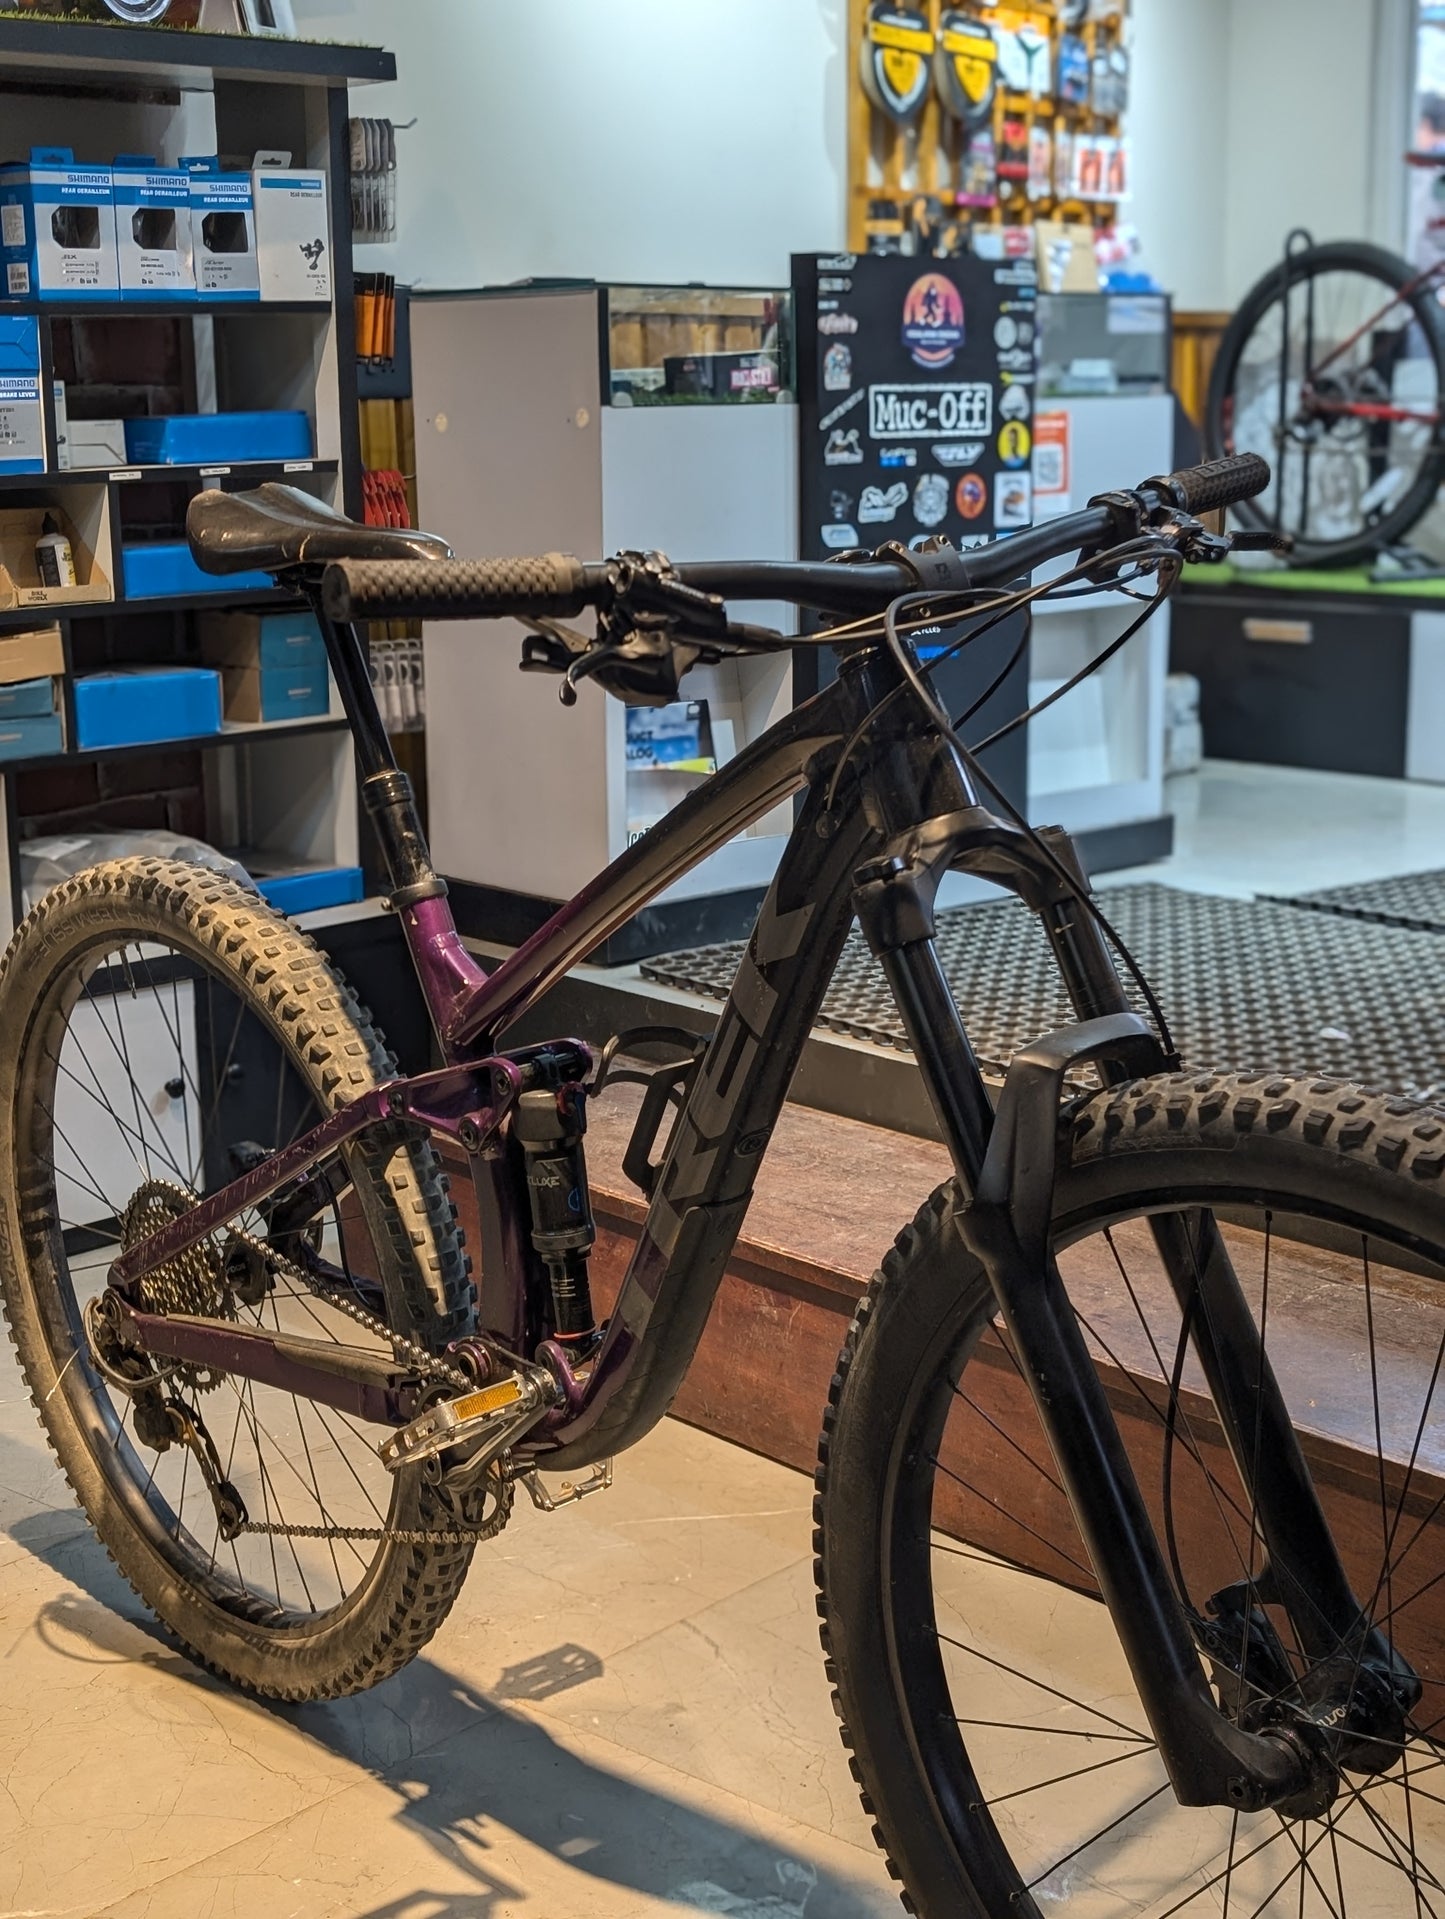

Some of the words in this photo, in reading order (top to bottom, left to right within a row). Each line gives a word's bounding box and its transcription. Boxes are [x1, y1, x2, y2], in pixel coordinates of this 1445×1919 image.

[67, 174, 110, 184] SHIMANO
[145, 176, 188, 186] SHIMANO
[209, 184, 248, 193] SHIMANO
[0, 379, 36, 388] HIMANO
[876, 392, 986, 431] Muc-Off
